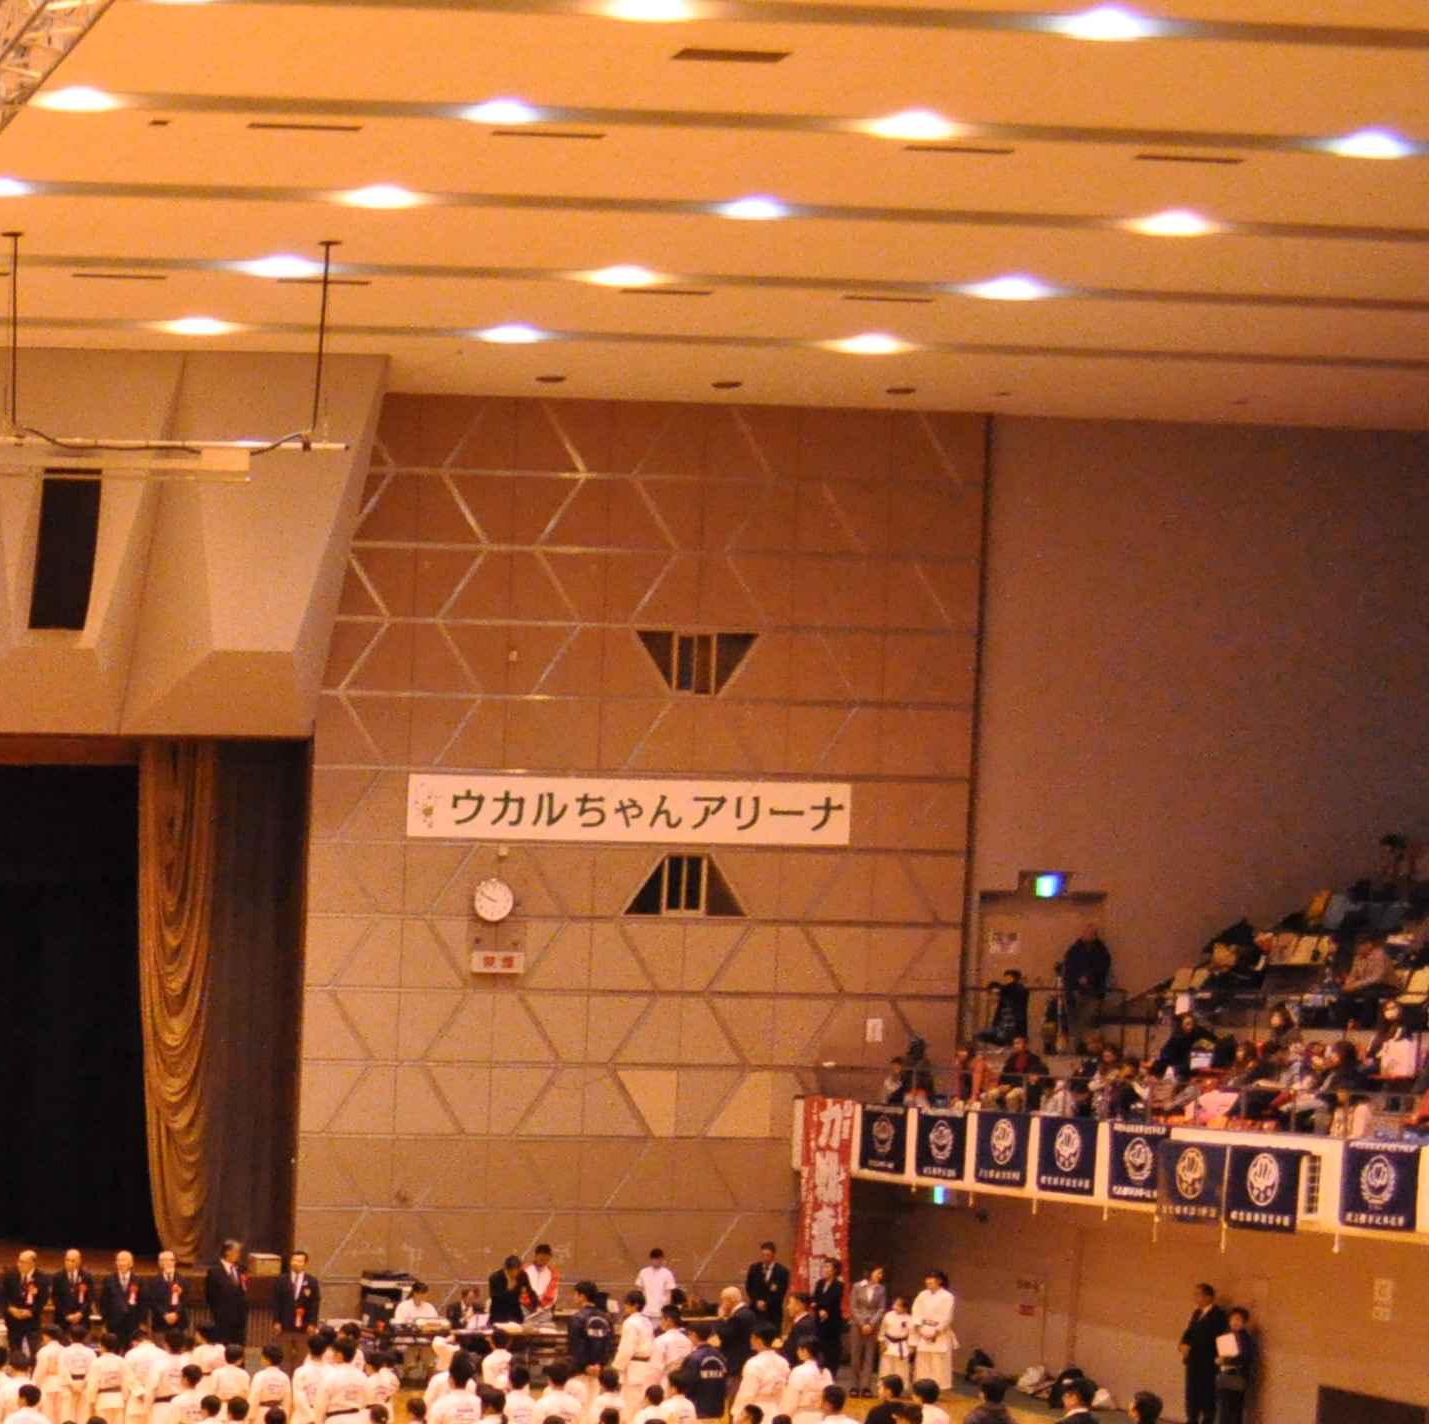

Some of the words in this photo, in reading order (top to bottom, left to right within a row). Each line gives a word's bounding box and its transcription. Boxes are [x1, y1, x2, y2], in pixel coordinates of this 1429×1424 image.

[451, 788, 845, 832] ウカルちゃんアリーナ
